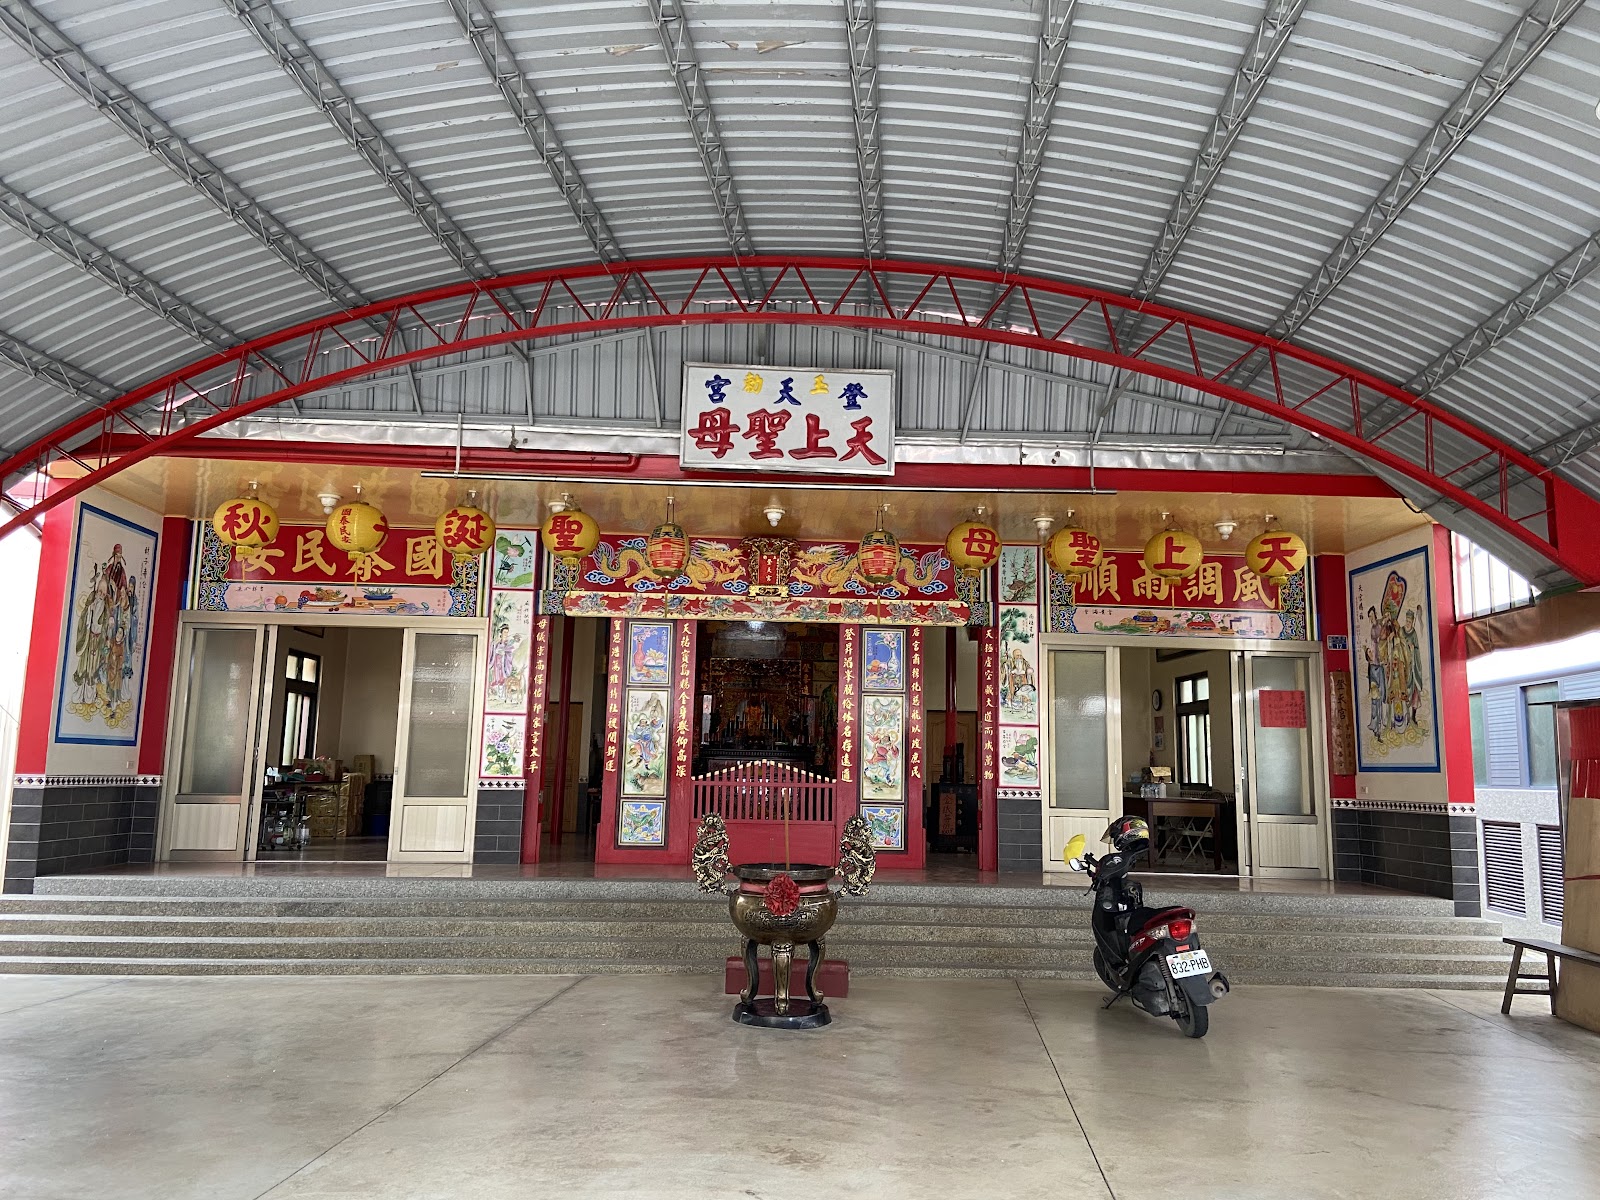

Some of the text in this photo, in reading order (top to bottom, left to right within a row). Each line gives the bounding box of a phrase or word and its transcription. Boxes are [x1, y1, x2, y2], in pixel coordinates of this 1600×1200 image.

[687, 406, 887, 466] 天上聖母
[221, 502, 271, 543] 秋
[339, 508, 353, 544] 國泰民安
[442, 508, 489, 550] 誕
[548, 515, 585, 552] 聖
[961, 527, 1000, 564] 母
[1068, 530, 1101, 569] 聖
[1153, 535, 1190, 571] 上
[1256, 536, 1299, 574] 天
[1080, 555, 1276, 610] 風調雨順
[1170, 957, 1210, 975] 832-PHB
